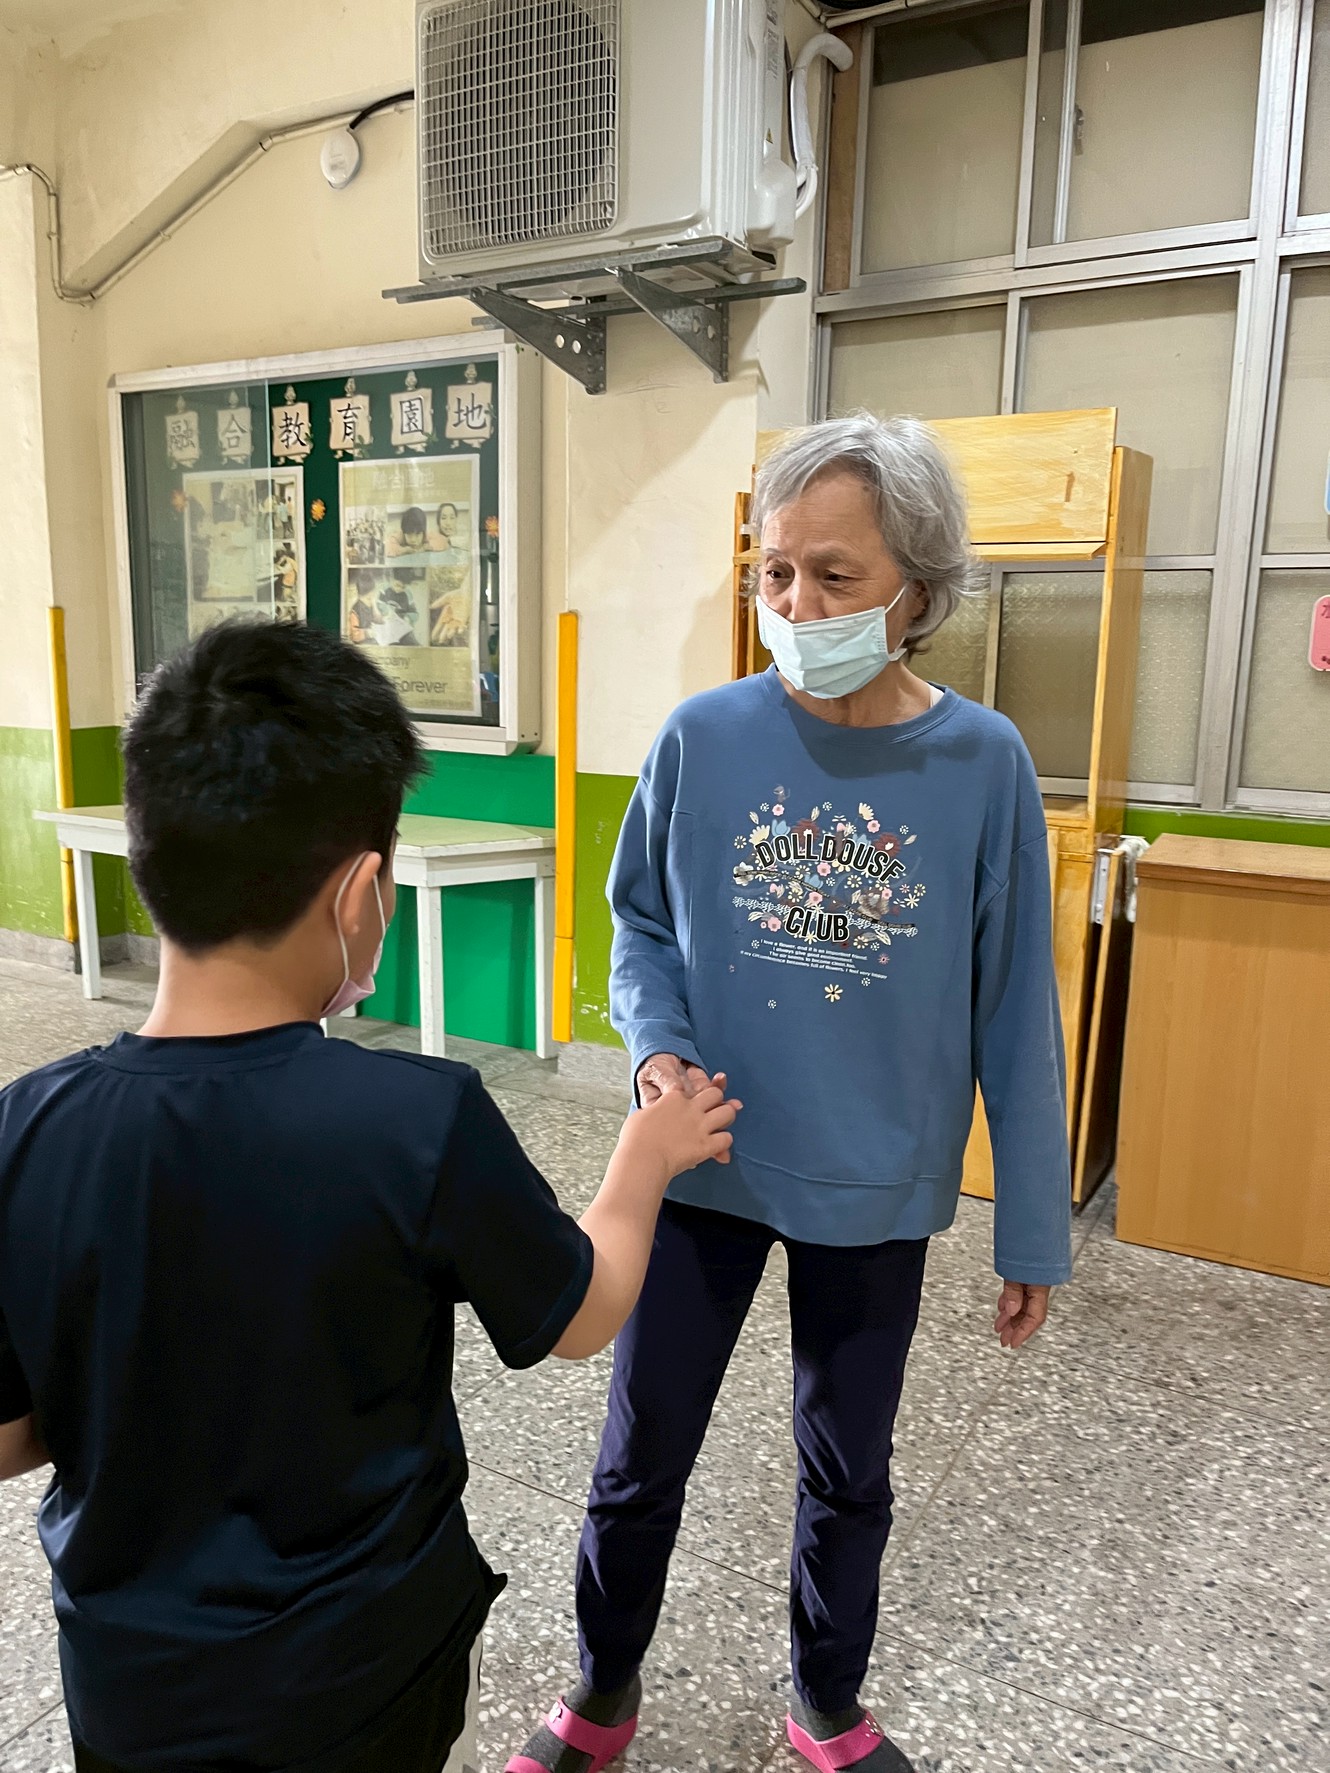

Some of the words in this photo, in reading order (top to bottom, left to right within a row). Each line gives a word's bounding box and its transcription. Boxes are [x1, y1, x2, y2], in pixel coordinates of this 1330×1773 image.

[170, 391, 488, 450] 融合教育園地
[754, 832, 819, 868] DOLL
